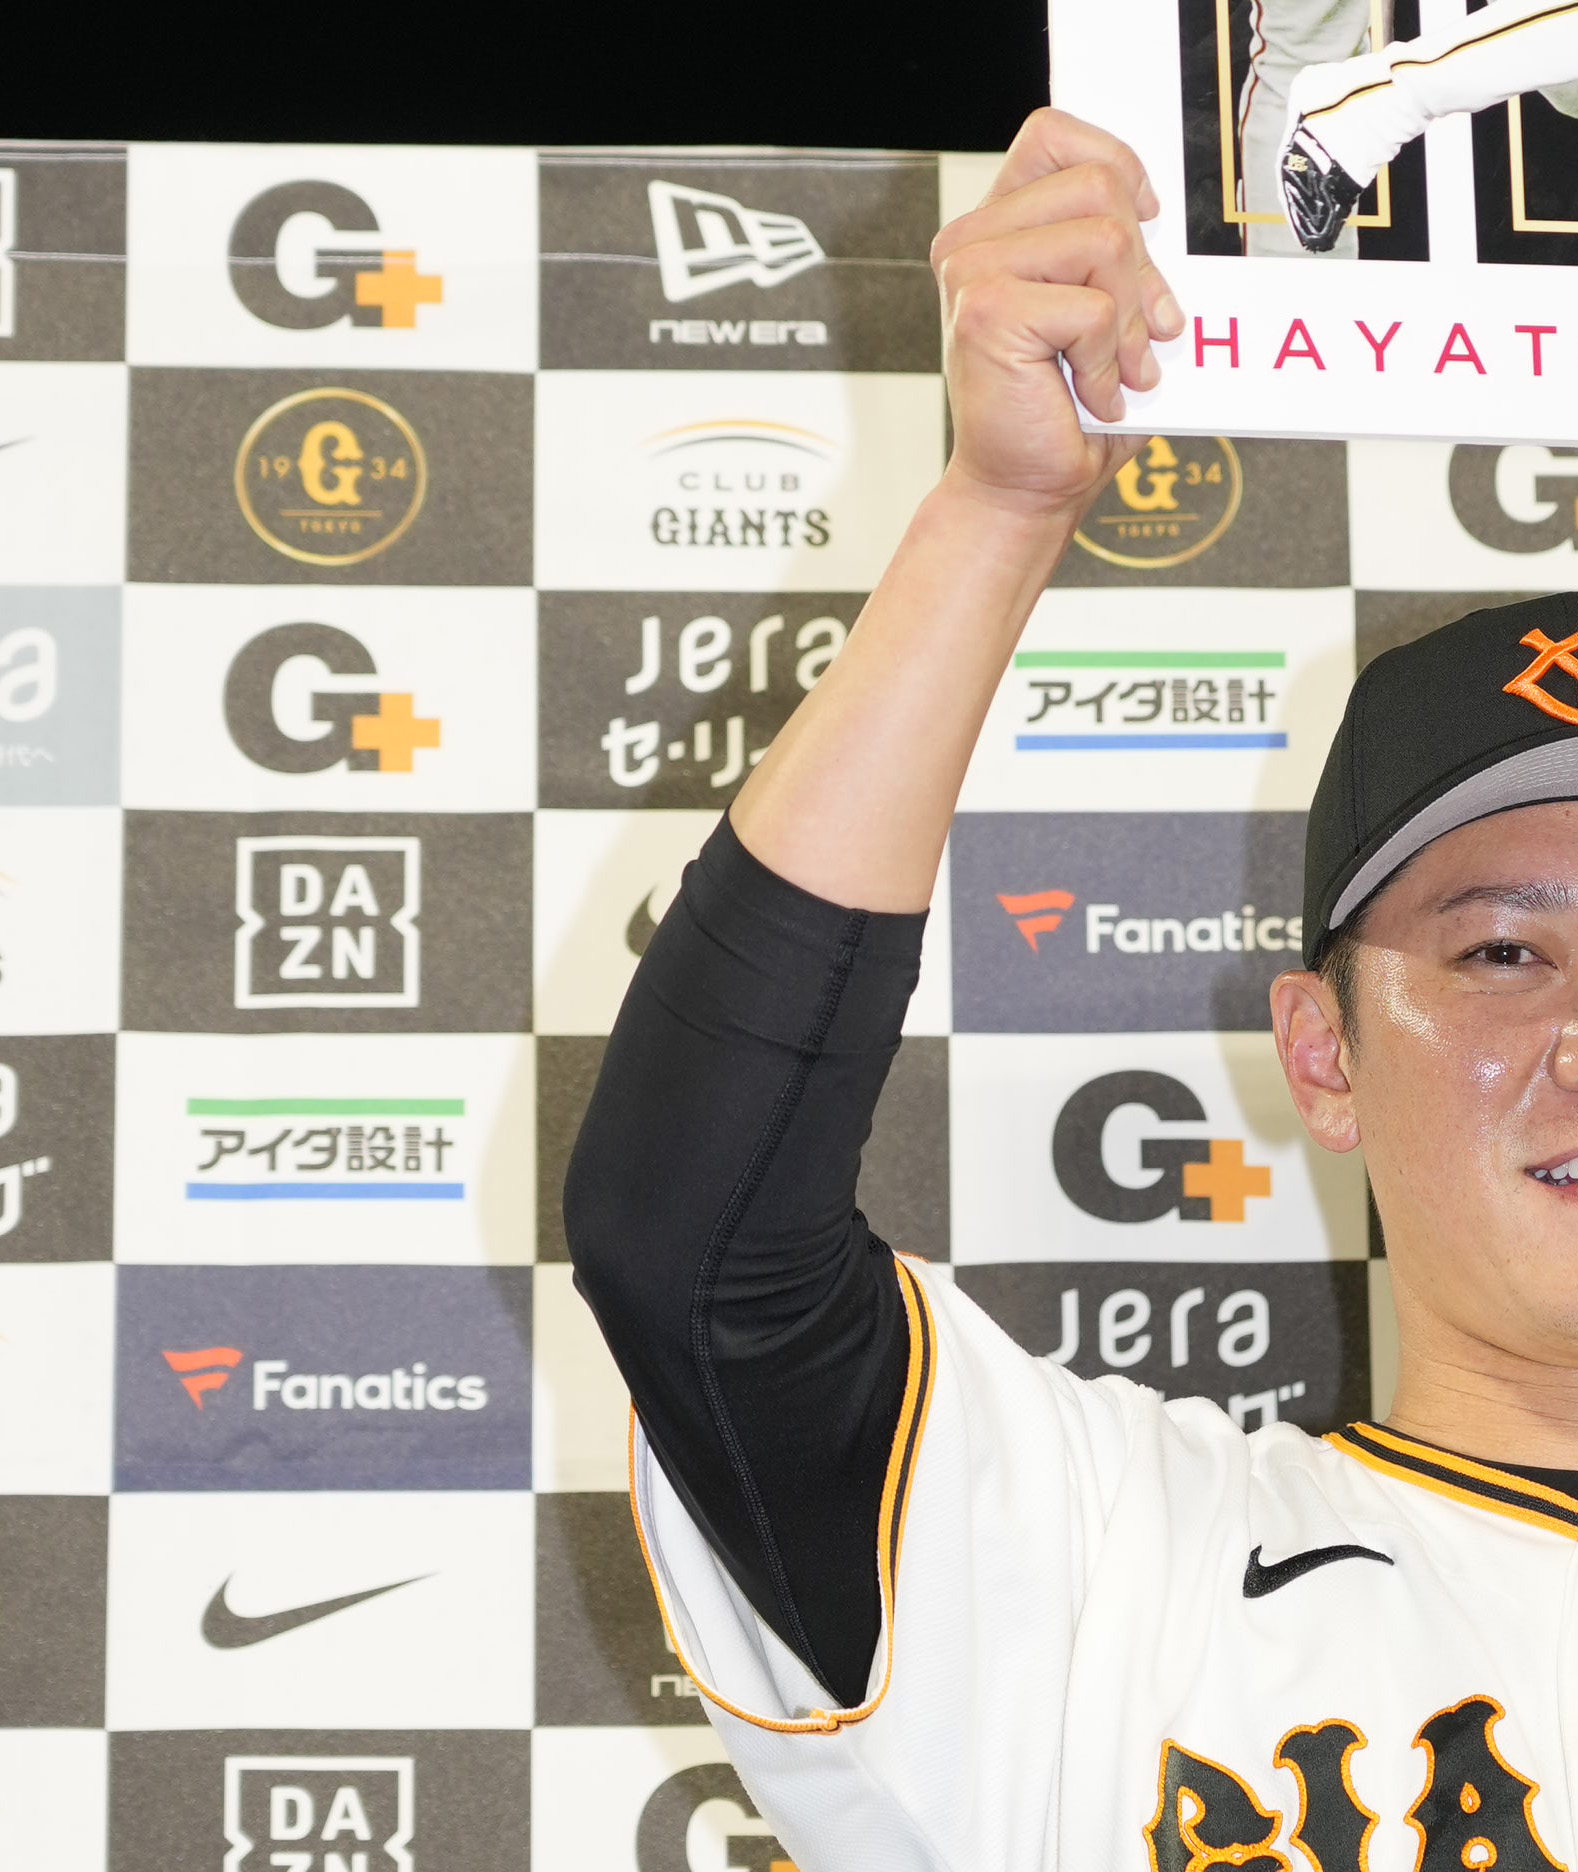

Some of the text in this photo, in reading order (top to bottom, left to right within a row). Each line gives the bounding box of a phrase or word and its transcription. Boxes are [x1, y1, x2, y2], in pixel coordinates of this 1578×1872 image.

[228, 180, 441, 330] G+
[260, 422, 407, 505] 19 G 34
[679, 473, 800, 492] CLUB
[1187, 463, 1221, 484] 34
[651, 508, 831, 548] GIANTS
[223, 622, 439, 774] G+
[1027, 679, 1275, 723] アイダ設計
[601, 715, 772, 788] セ・リ
[281, 864, 379, 916] DA
[280, 926, 375, 979] ZN
[1087, 901, 1308, 959] Fanatics
[199, 1126, 453, 1172] アイダ設計
[1052, 1070, 1270, 1224] G+
[254, 1361, 487, 1410] Fanatics
[271, 1786, 371, 1840] DA
